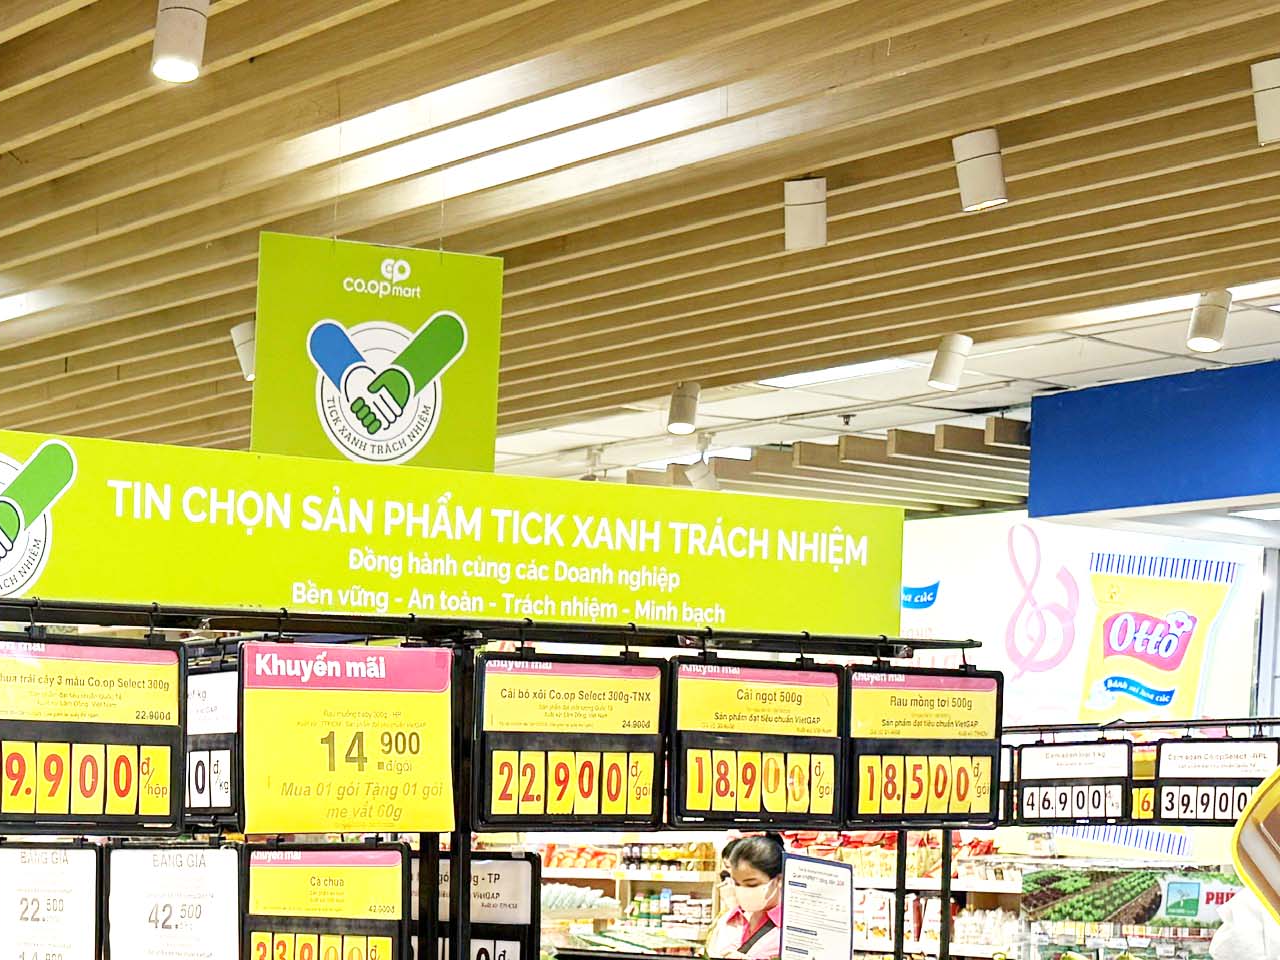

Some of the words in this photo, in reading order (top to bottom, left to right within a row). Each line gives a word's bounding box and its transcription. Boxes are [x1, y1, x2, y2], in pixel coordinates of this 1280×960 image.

[327, 396, 341, 429] TICK
[338, 426, 368, 452] XANH
[370, 438, 408, 455] TRÁCH
[407, 404, 432, 441] NHIỆM
[107, 479, 171, 521] TIN
[182, 486, 291, 536] CHỌN
[301, 486, 373, 536] SẢN
[384, 491, 482, 542] PHẨM
[491, 507, 566, 547] TICK
[571, 515, 660, 553] XANH
[669, 517, 769, 560] TRÁCH
[776, 525, 868, 573] NHIỆM
[18, 537, 42, 578] NHIỆM
[349, 547, 403, 578] Đồng
[408, 549, 458, 577] hành
[463, 552, 510, 583] cùng
[516, 560, 549, 583] các
[554, 560, 614, 585] Doanh
[617, 567, 680, 593] nghiệp
[292, 580, 333, 606] Bền
[337, 585, 389, 613] vững
[408, 588, 435, 610] An
[440, 588, 484, 612] toàn
[502, 593, 556, 616] Trách
[560, 597, 617, 622] nhiệm
[635, 600, 678, 621] Minh
[681, 604, 725, 626] bạch
[57, 675, 62, 686] 3
[117, 678, 146, 689] Select
[255, 651, 341, 682] Khuyến
[346, 655, 386, 678] mãi
[548, 690, 576, 703] Co.op
[578, 690, 606, 701] Select
[755, 691, 777, 705] ngọt
[779, 691, 803, 706] 500g
[890, 695, 908, 707] Rau
[951, 697, 973, 710] 500g
[320, 731, 368, 772] 14
[380, 731, 421, 755] 900
[280, 782, 311, 797] Mua
[316, 782, 332, 796] 01
[337, 781, 360, 800] gói
[402, 782, 418, 796] 01
[422, 781, 444, 800] gói
[498, 760, 621, 802] 22.900
[695, 756, 805, 802] 18.900
[867, 764, 969, 801] 18.500
[377, 804, 403, 821] 60g
[1026, 790, 1101, 811] 46.900
[1164, 790, 1247, 814] 39.900
[487, 873, 501, 884] TP
